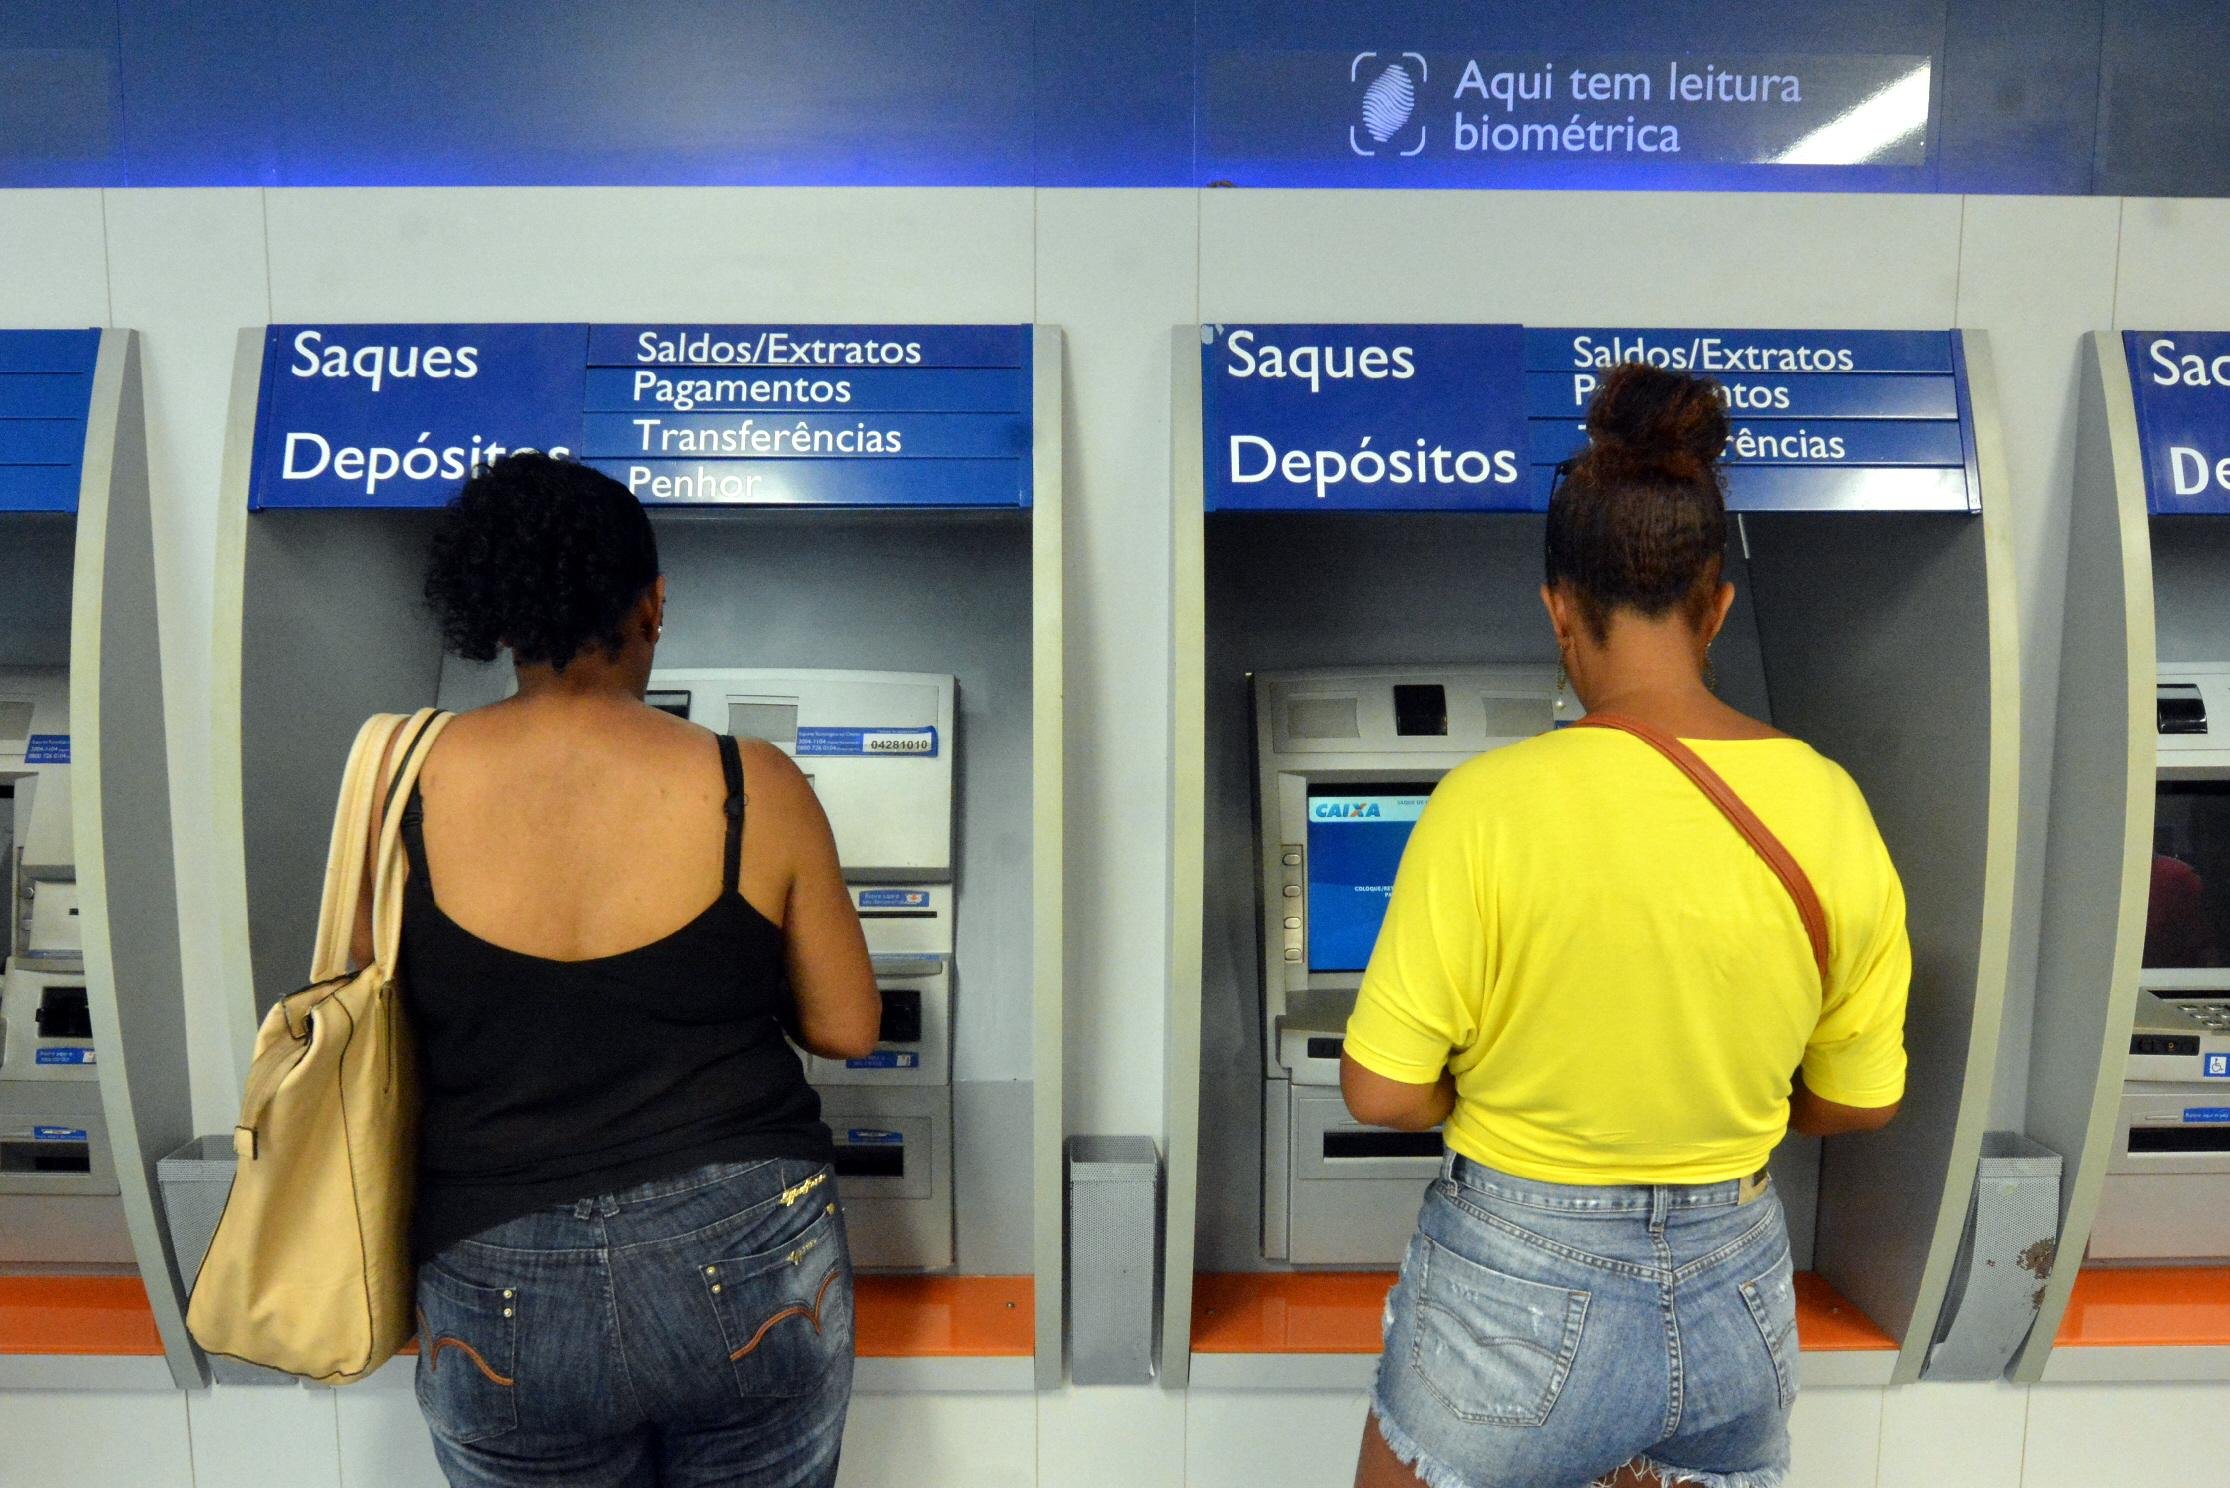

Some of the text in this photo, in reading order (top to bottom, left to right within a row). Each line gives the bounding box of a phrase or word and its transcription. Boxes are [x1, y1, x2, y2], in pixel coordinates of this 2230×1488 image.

[1453, 59, 1802, 112] Aqui tem leitura
[1454, 113, 1680, 153] biométrica
[291, 330, 478, 392] Saques
[637, 332, 922, 365] Saldos/Extratos
[1227, 329, 1415, 393] Saques
[1573, 336, 1854, 371] Saldos/Extratos
[633, 370, 851, 411] Pagamentos
[1574, 374, 1790, 408] Pntos
[632, 418, 902, 453] Transferências
[282, 431, 570, 496] Depósit
[629, 465, 762, 498] Penhor
[1230, 433, 1518, 498] Depósitos
[870, 739, 928, 750] 04281010
[1315, 803, 1381, 818] CAIXA
